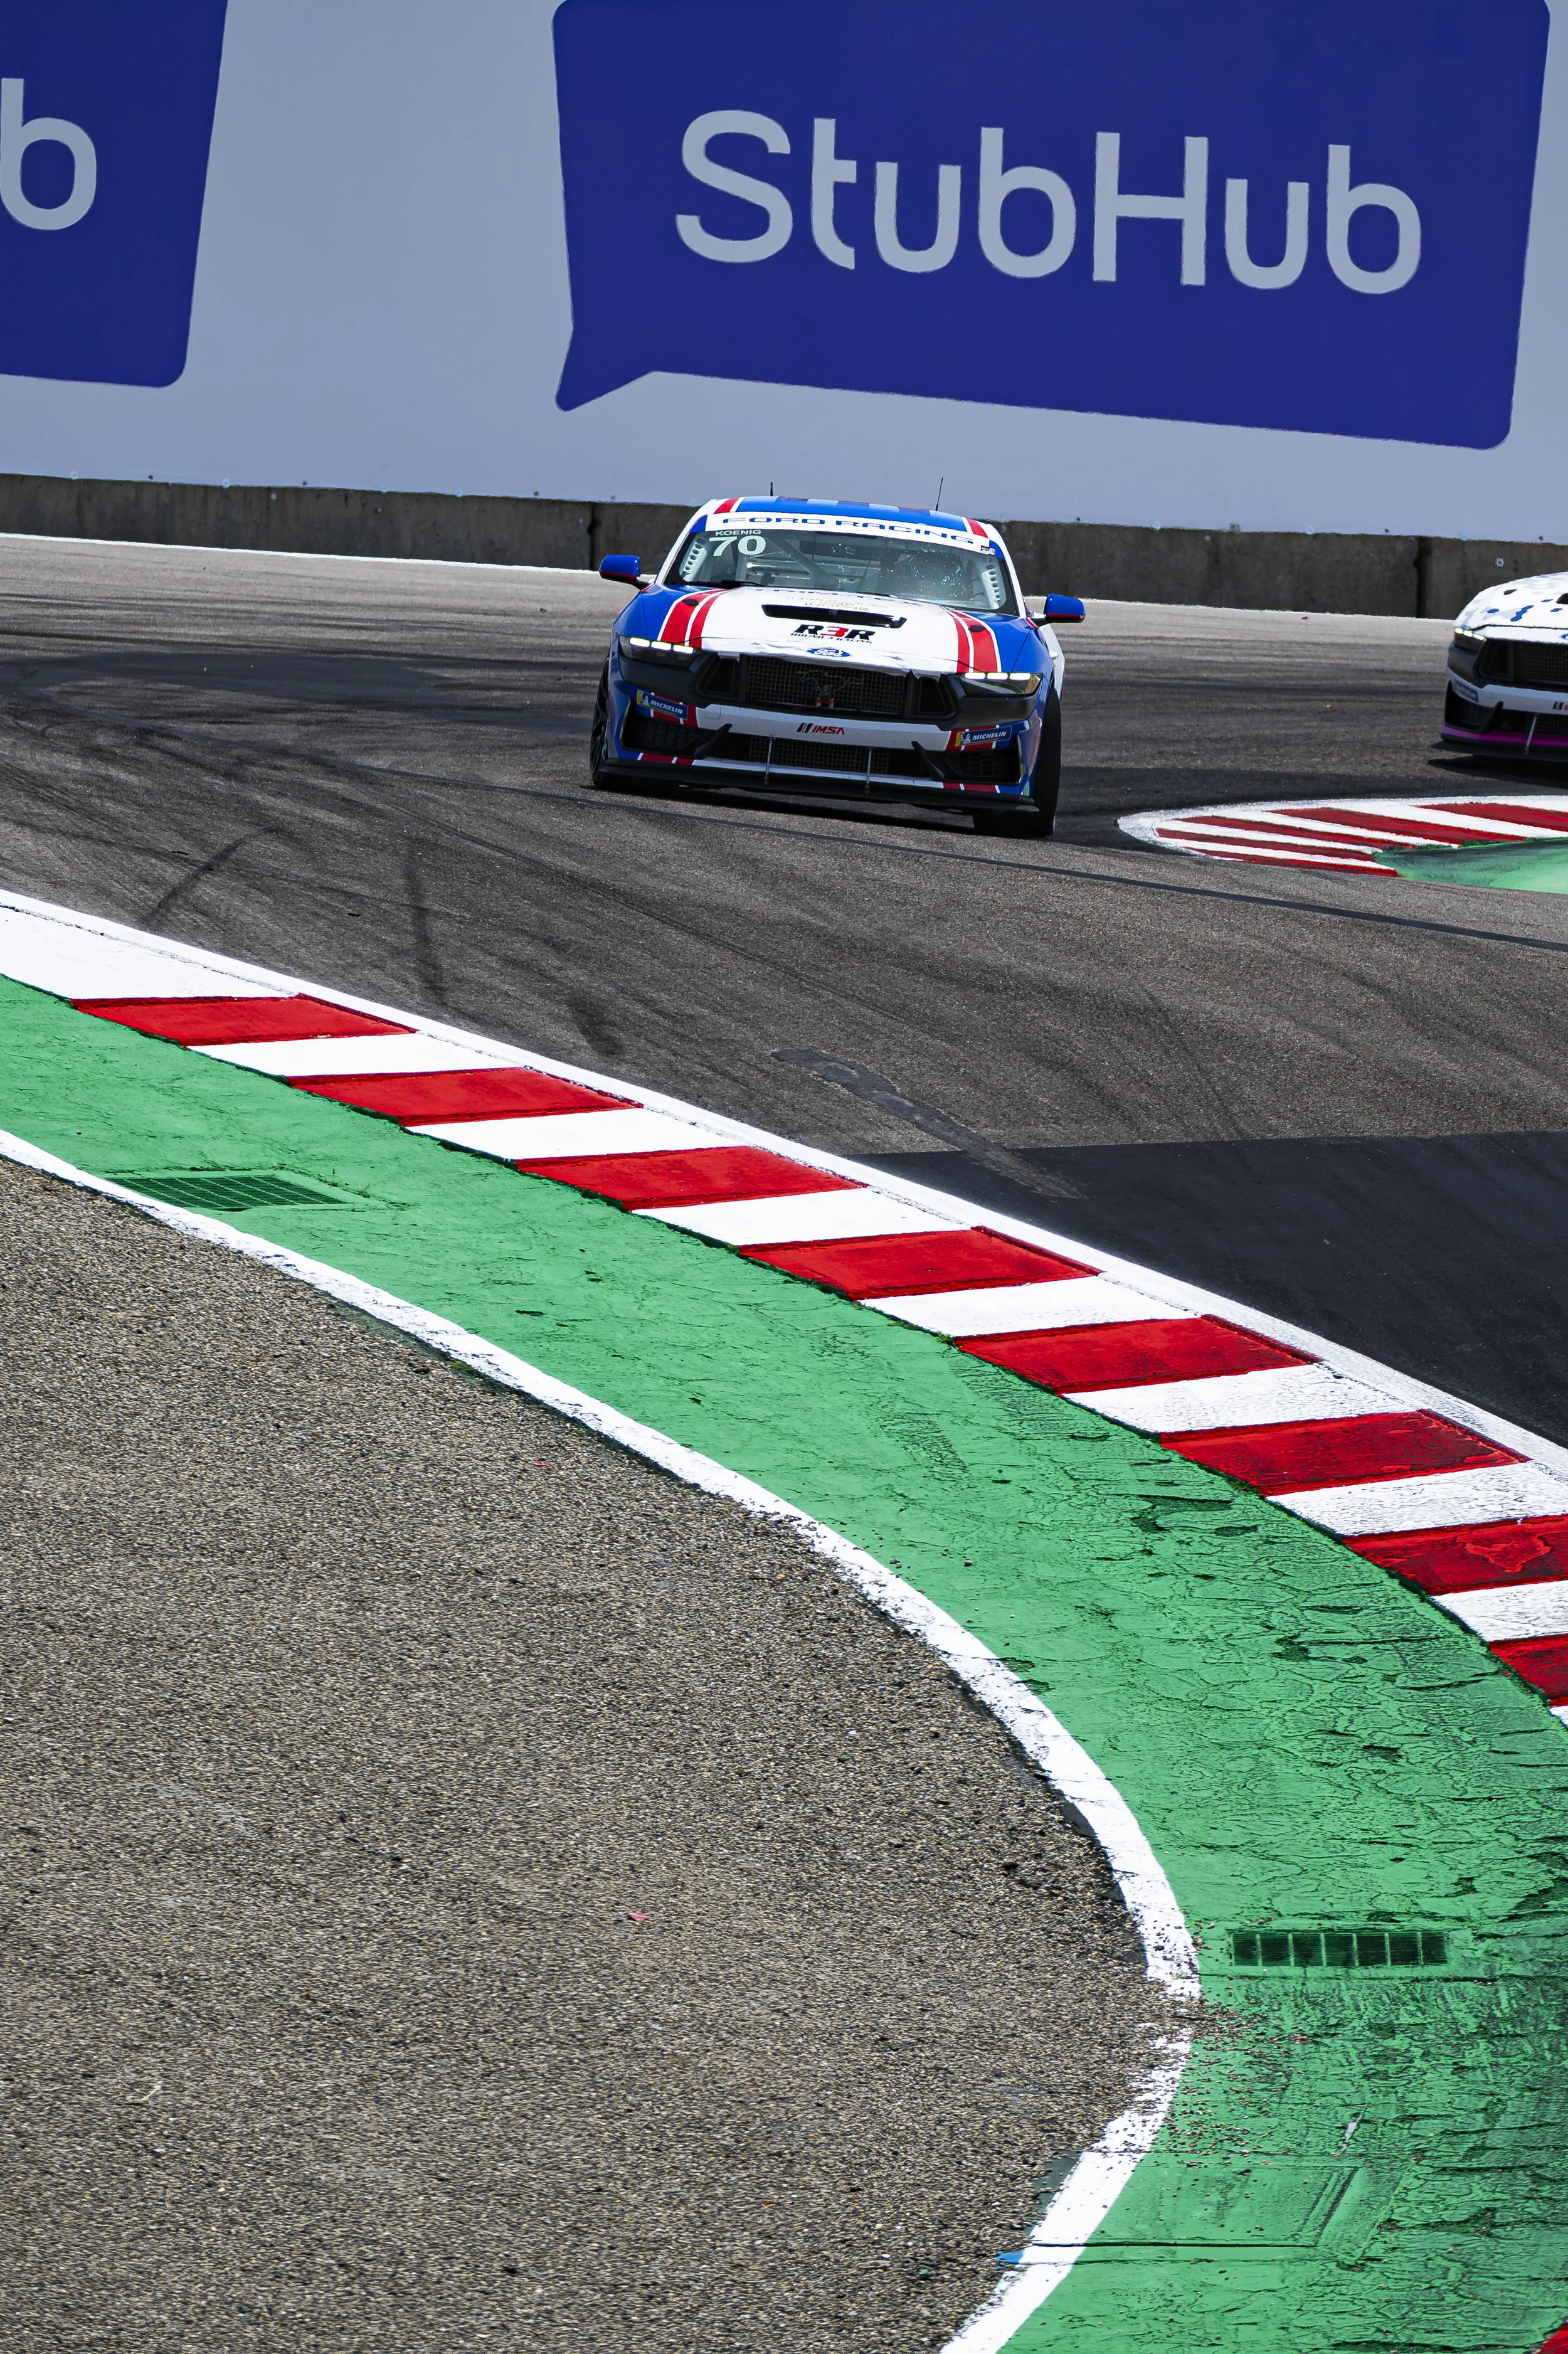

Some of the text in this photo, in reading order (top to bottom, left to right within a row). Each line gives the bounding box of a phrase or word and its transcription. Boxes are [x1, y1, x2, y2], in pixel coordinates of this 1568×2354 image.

[676, 110, 1421, 294] StubHub
[835, 520, 973, 544] RACING
[709, 535, 766, 556] 70
[793, 624, 876, 640] R3R
[815, 649, 844, 657] Ford
[650, 699, 683, 714] MICHELIN
[812, 725, 845, 735] IMSA
[972, 731, 1007, 741] MICHELIN
